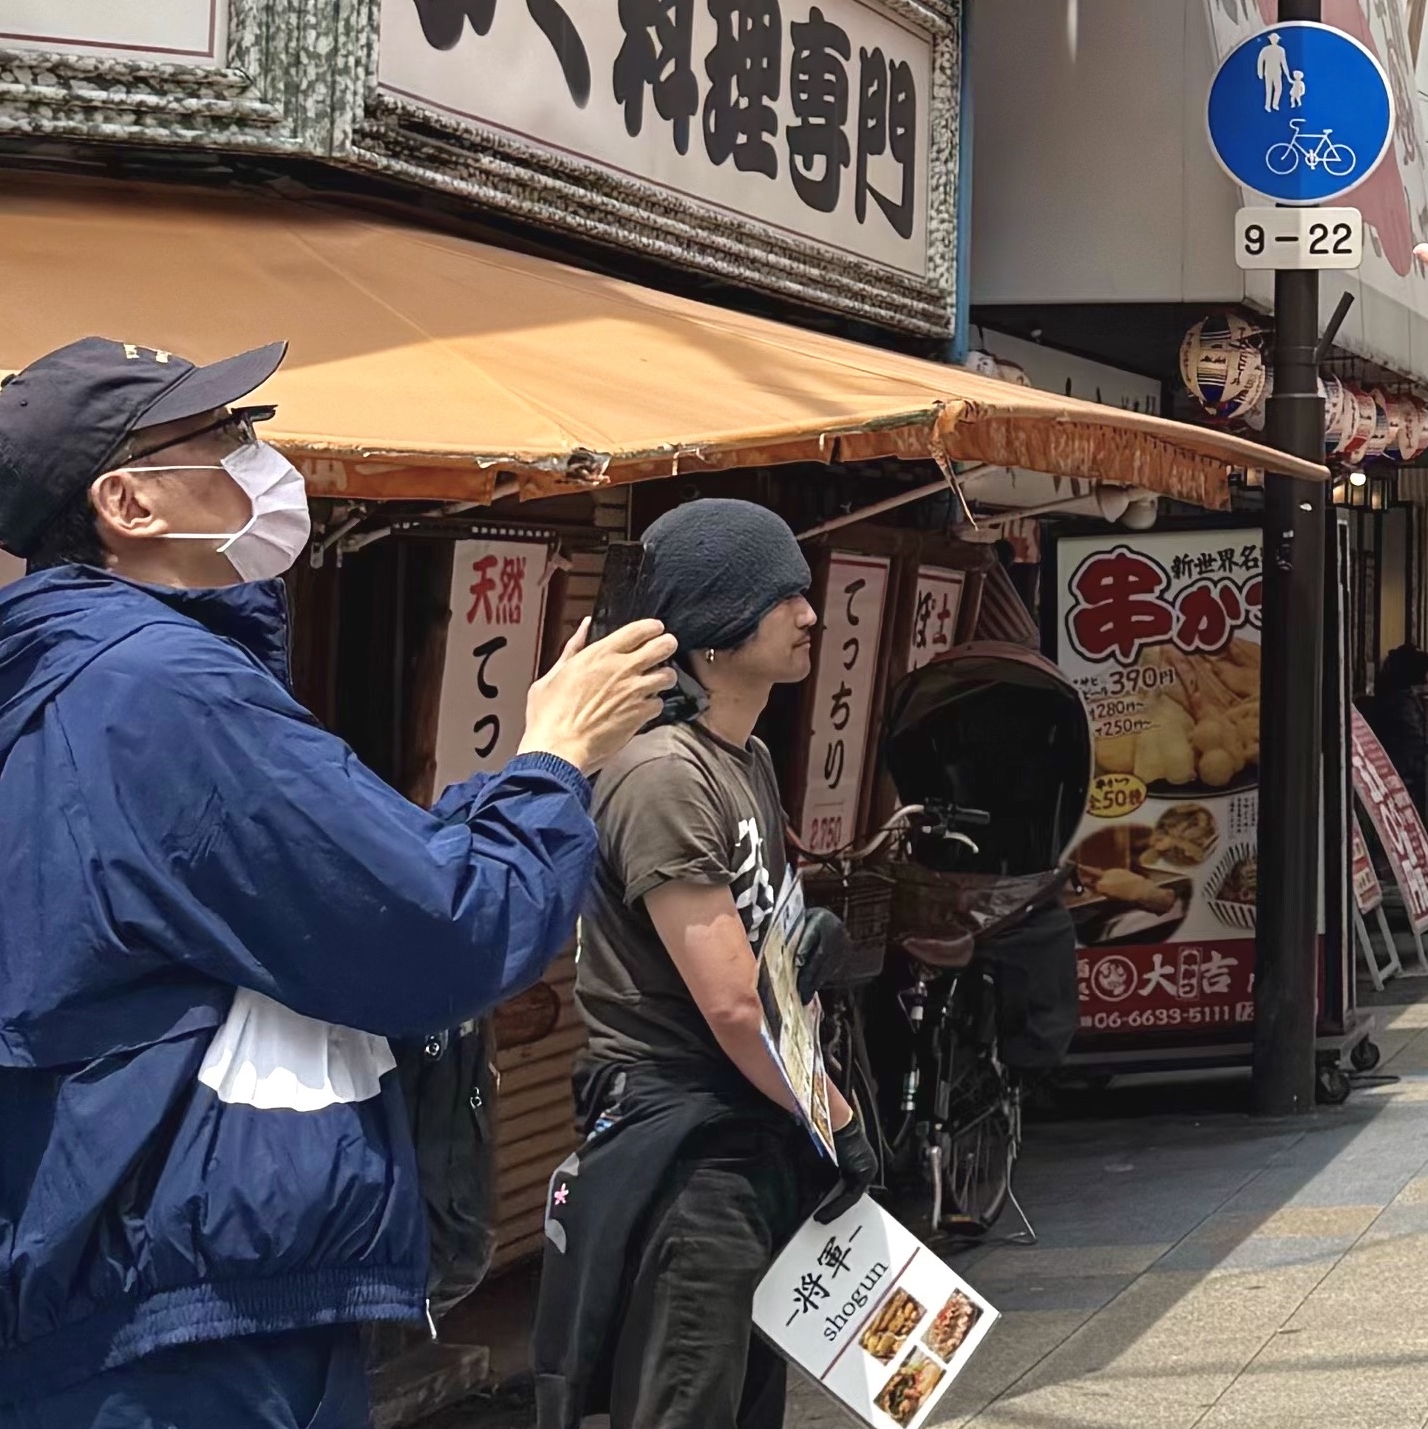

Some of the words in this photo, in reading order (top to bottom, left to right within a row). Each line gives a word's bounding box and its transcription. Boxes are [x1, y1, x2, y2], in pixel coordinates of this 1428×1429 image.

[1244, 223, 1353, 256] 9-22
[466, 555, 526, 625] 天然
[823, 1260, 888, 1341] shogun
